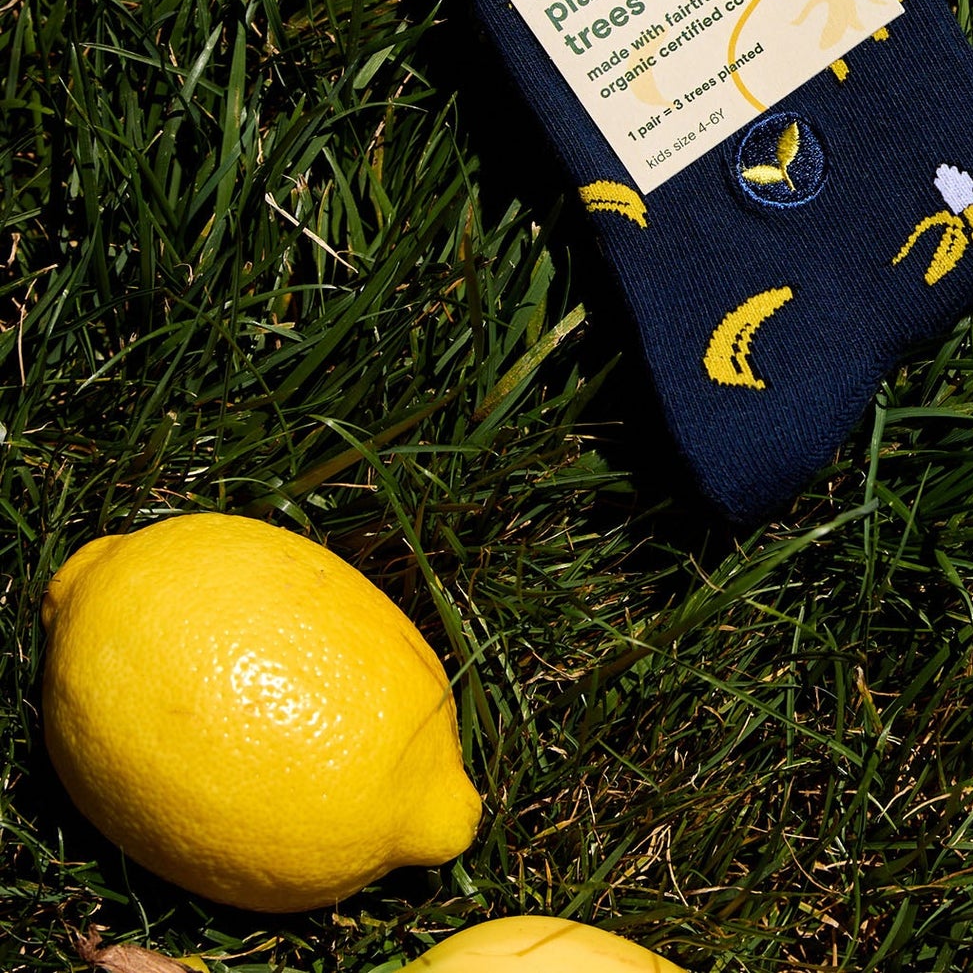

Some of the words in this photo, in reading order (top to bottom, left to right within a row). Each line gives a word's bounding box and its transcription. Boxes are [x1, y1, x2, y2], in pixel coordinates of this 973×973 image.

[586, 48, 630, 82] made
[630, 24, 666, 51] with
[600, 56, 658, 99] organic
[659, 6, 724, 58] certified
[627, 131, 637, 141] 1
[637, 115, 662, 139] pair
[663, 107, 673, 117] =
[673, 98, 684, 111] 3
[684, 77, 717, 103] trees
[717, 42, 765, 83] planted
[645, 148, 673, 170] kids
[673, 131, 697, 152] size
